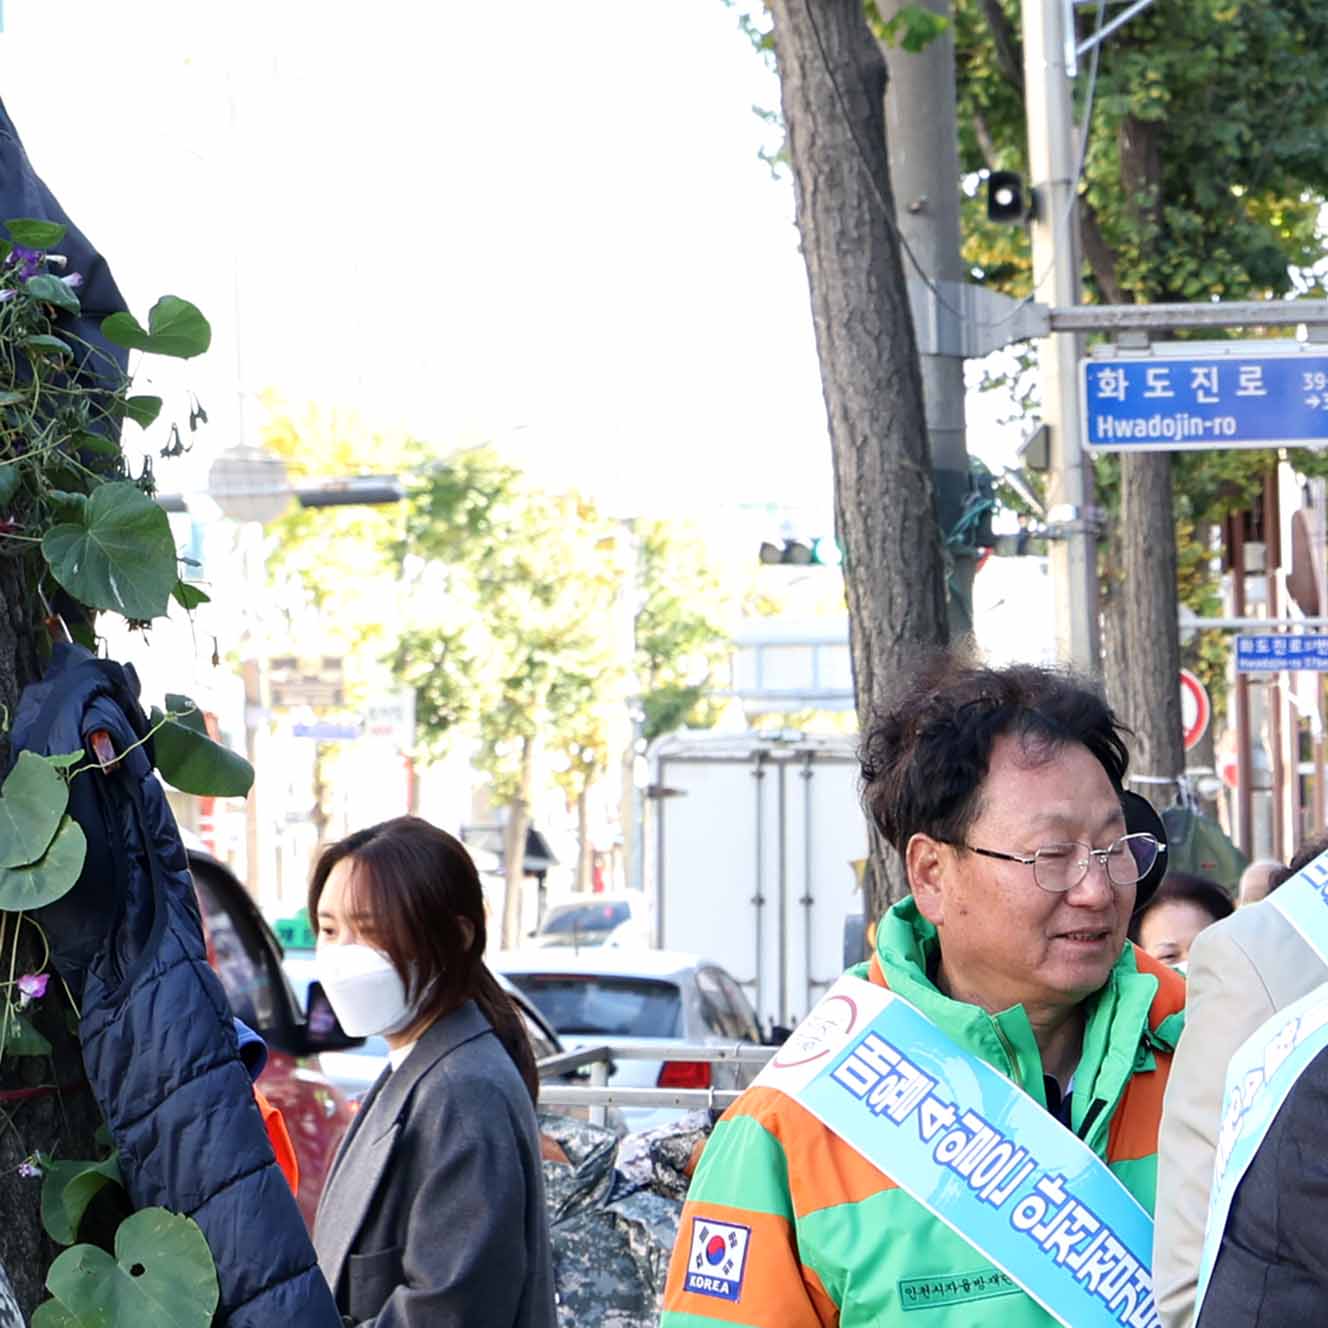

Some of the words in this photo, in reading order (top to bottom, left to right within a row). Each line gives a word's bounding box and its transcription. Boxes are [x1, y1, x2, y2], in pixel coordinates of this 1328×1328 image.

[1097, 365, 1268, 404] 화도진로
[1097, 414, 1237, 441] Hwadojin-ro
[830, 1030, 939, 1127] 매월
[917, 1095, 1039, 1212] 4일은
[688, 1275, 730, 1295] KOREA
